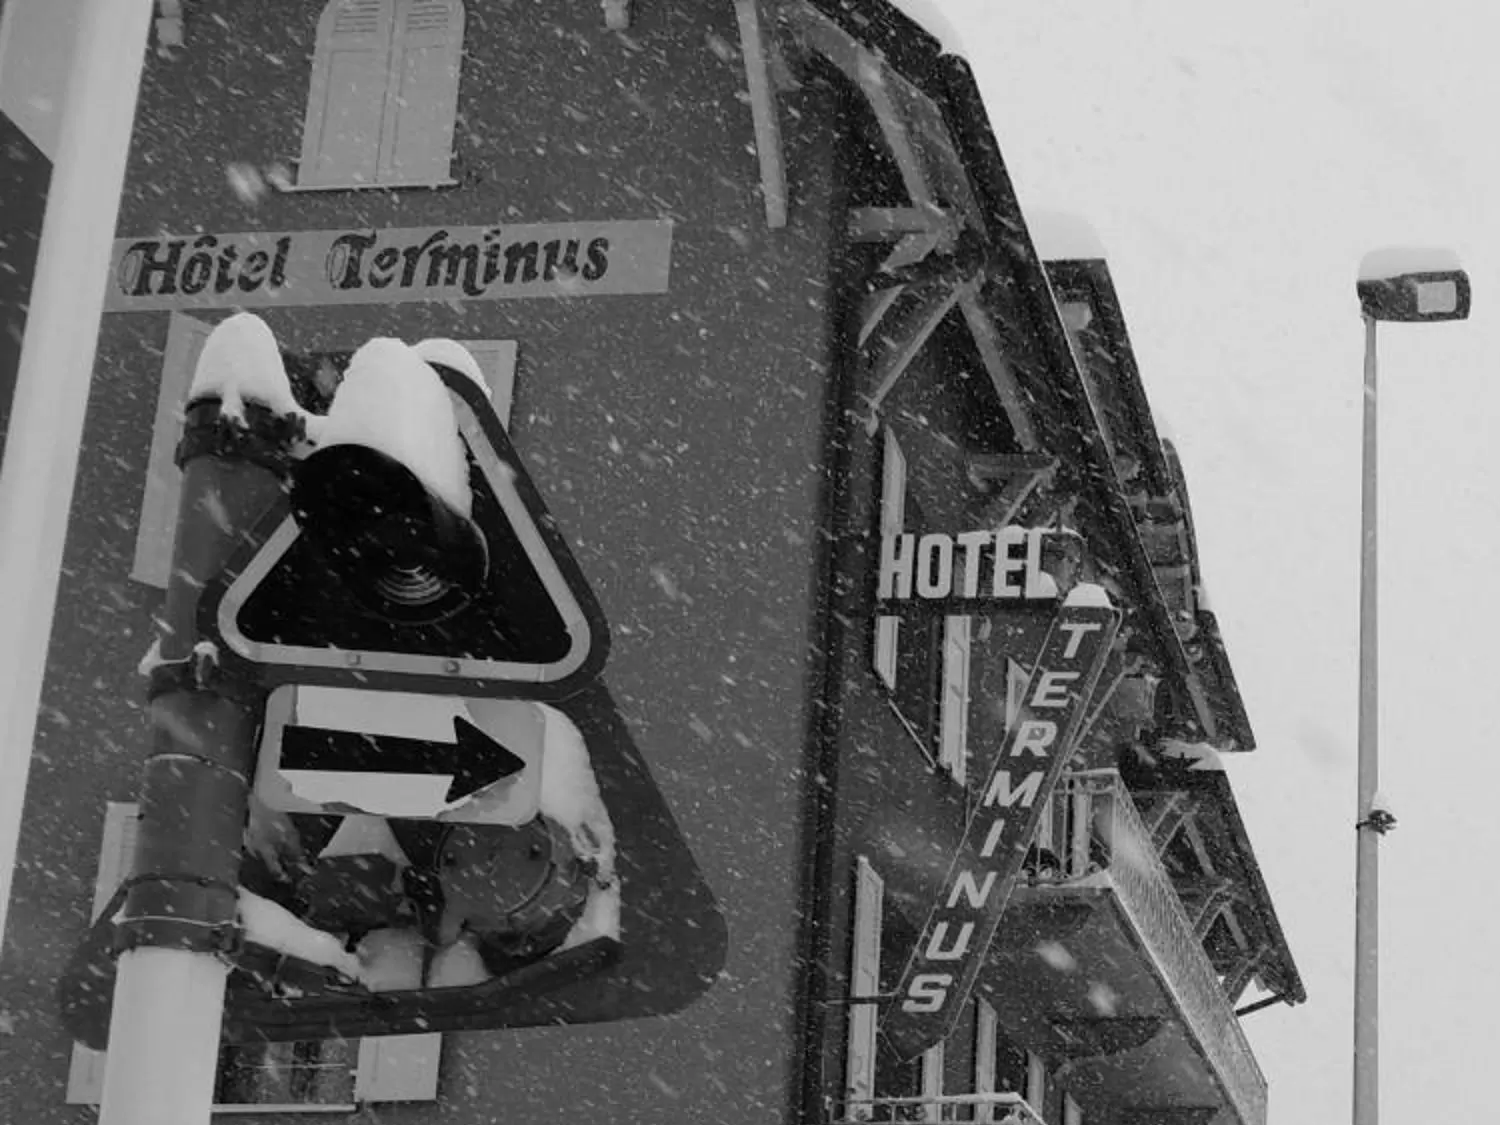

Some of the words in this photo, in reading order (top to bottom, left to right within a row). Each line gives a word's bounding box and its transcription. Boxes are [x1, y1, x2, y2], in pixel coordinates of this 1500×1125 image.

[119, 235, 292, 296] Hôtel
[326, 229, 610, 296] Terminus
[877, 526, 1059, 599] HOTEL
[901, 622, 1102, 1013] TERMINUS
